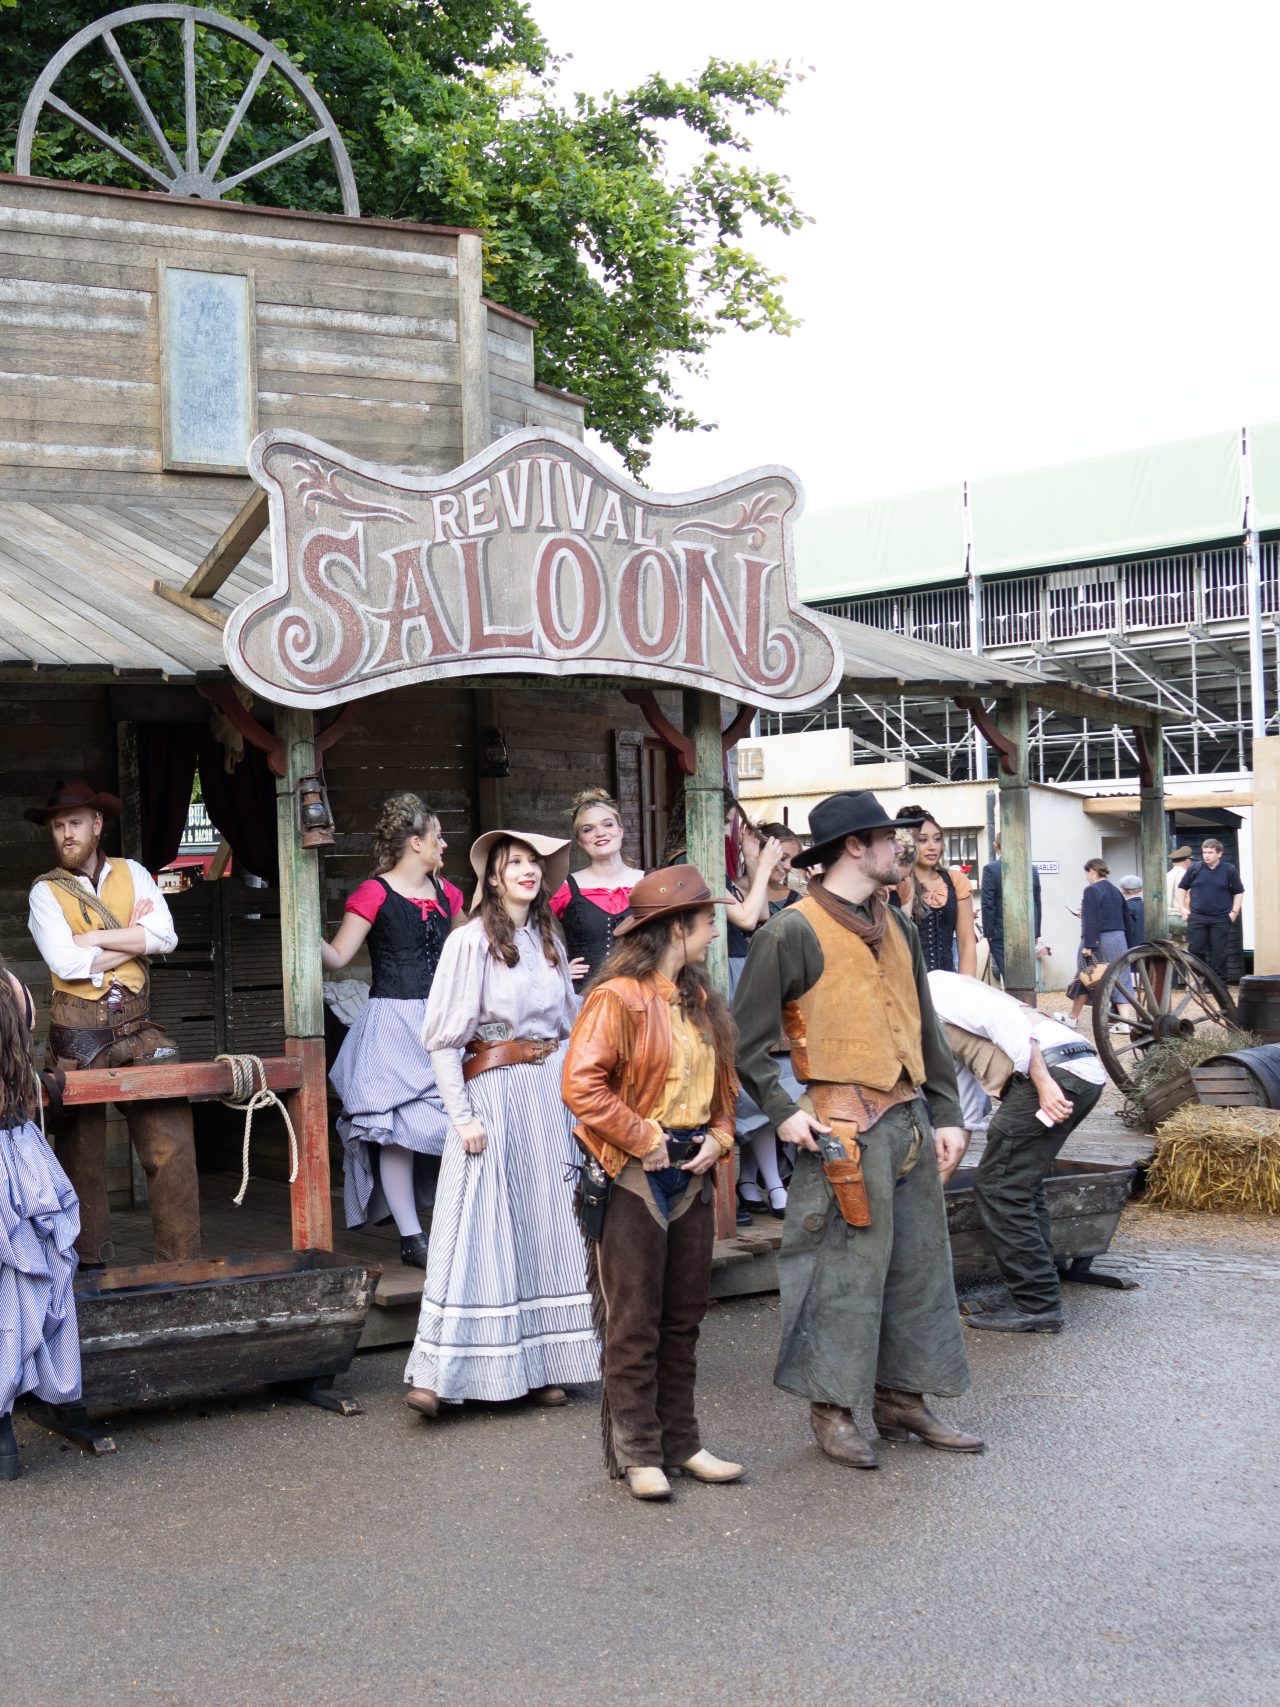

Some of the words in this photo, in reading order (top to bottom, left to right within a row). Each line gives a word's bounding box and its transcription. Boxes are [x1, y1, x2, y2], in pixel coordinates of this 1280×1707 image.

[434, 458, 658, 546] REVIVAL
[274, 521, 797, 693] SALOON
[738, 751, 756, 775] IL
[194, 829, 213, 842] BACON
